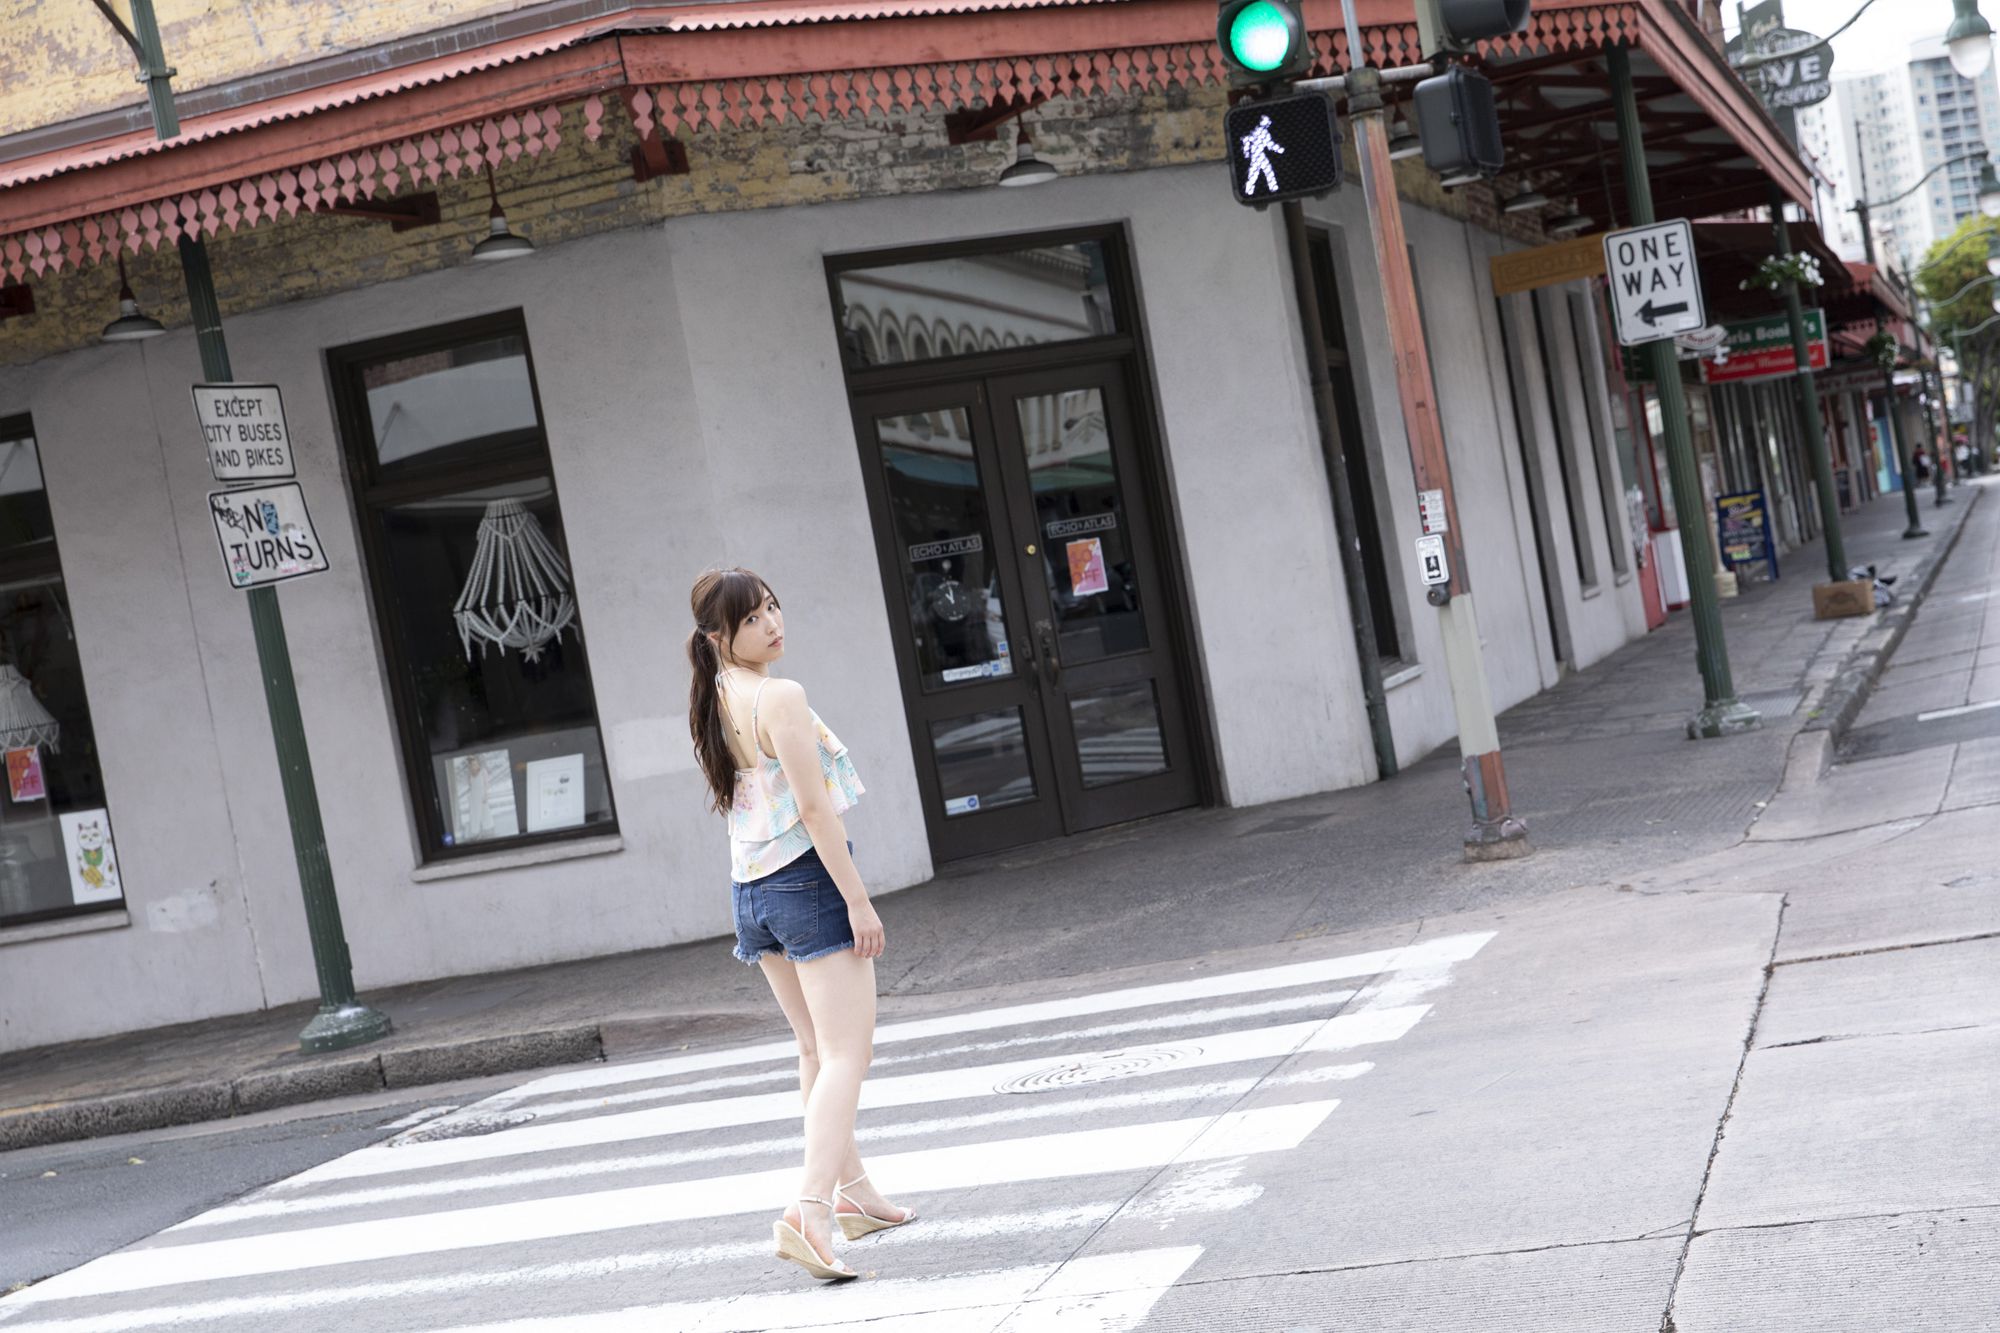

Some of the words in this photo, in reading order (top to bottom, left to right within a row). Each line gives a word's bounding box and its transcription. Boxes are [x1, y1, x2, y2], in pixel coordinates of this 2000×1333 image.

[1618, 232, 1681, 266] ONE
[1622, 262, 1685, 296] WAY
[214, 398, 263, 418] EXCEPT
[206, 424, 232, 443] CITY
[238, 423, 282, 442] BUSES
[215, 449, 241, 467] AND
[247, 448, 284, 467] BIKES
[1050, 524, 1078, 536] ECHO
[1084, 517, 1113, 530] ATLAS
[231, 534, 314, 571] TURNS
[912, 545, 942, 559] ECHO
[949, 538, 980, 555] ATLAS
[1073, 569, 1101, 586] OFF
